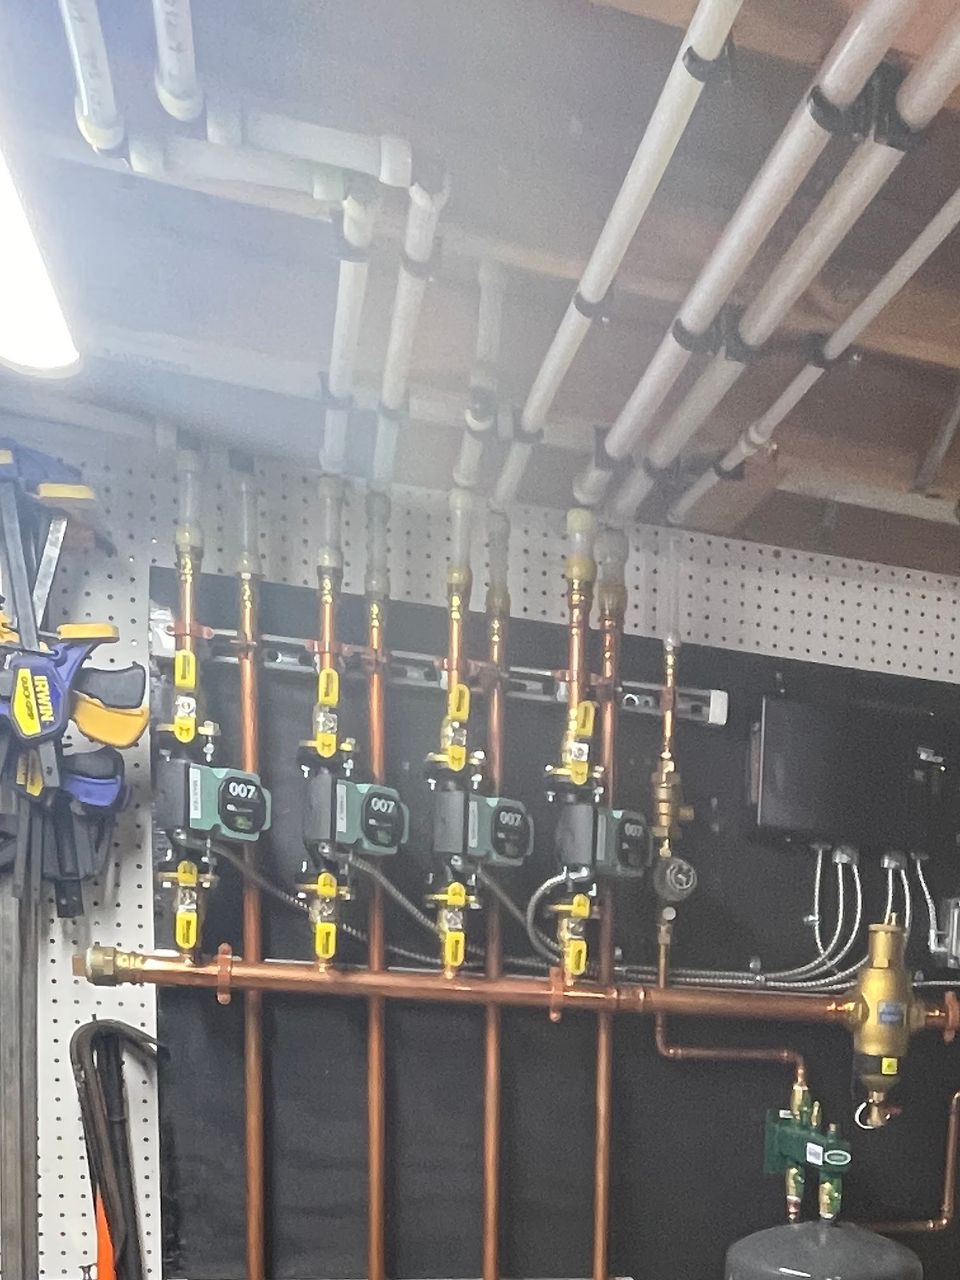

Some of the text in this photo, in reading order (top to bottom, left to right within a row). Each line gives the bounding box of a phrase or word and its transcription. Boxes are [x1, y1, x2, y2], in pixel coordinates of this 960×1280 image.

[33, 675, 55, 722] IRWIN
[228, 781, 256, 799] 007
[371, 797, 396, 814] 007
[499, 811, 522, 826] 007
